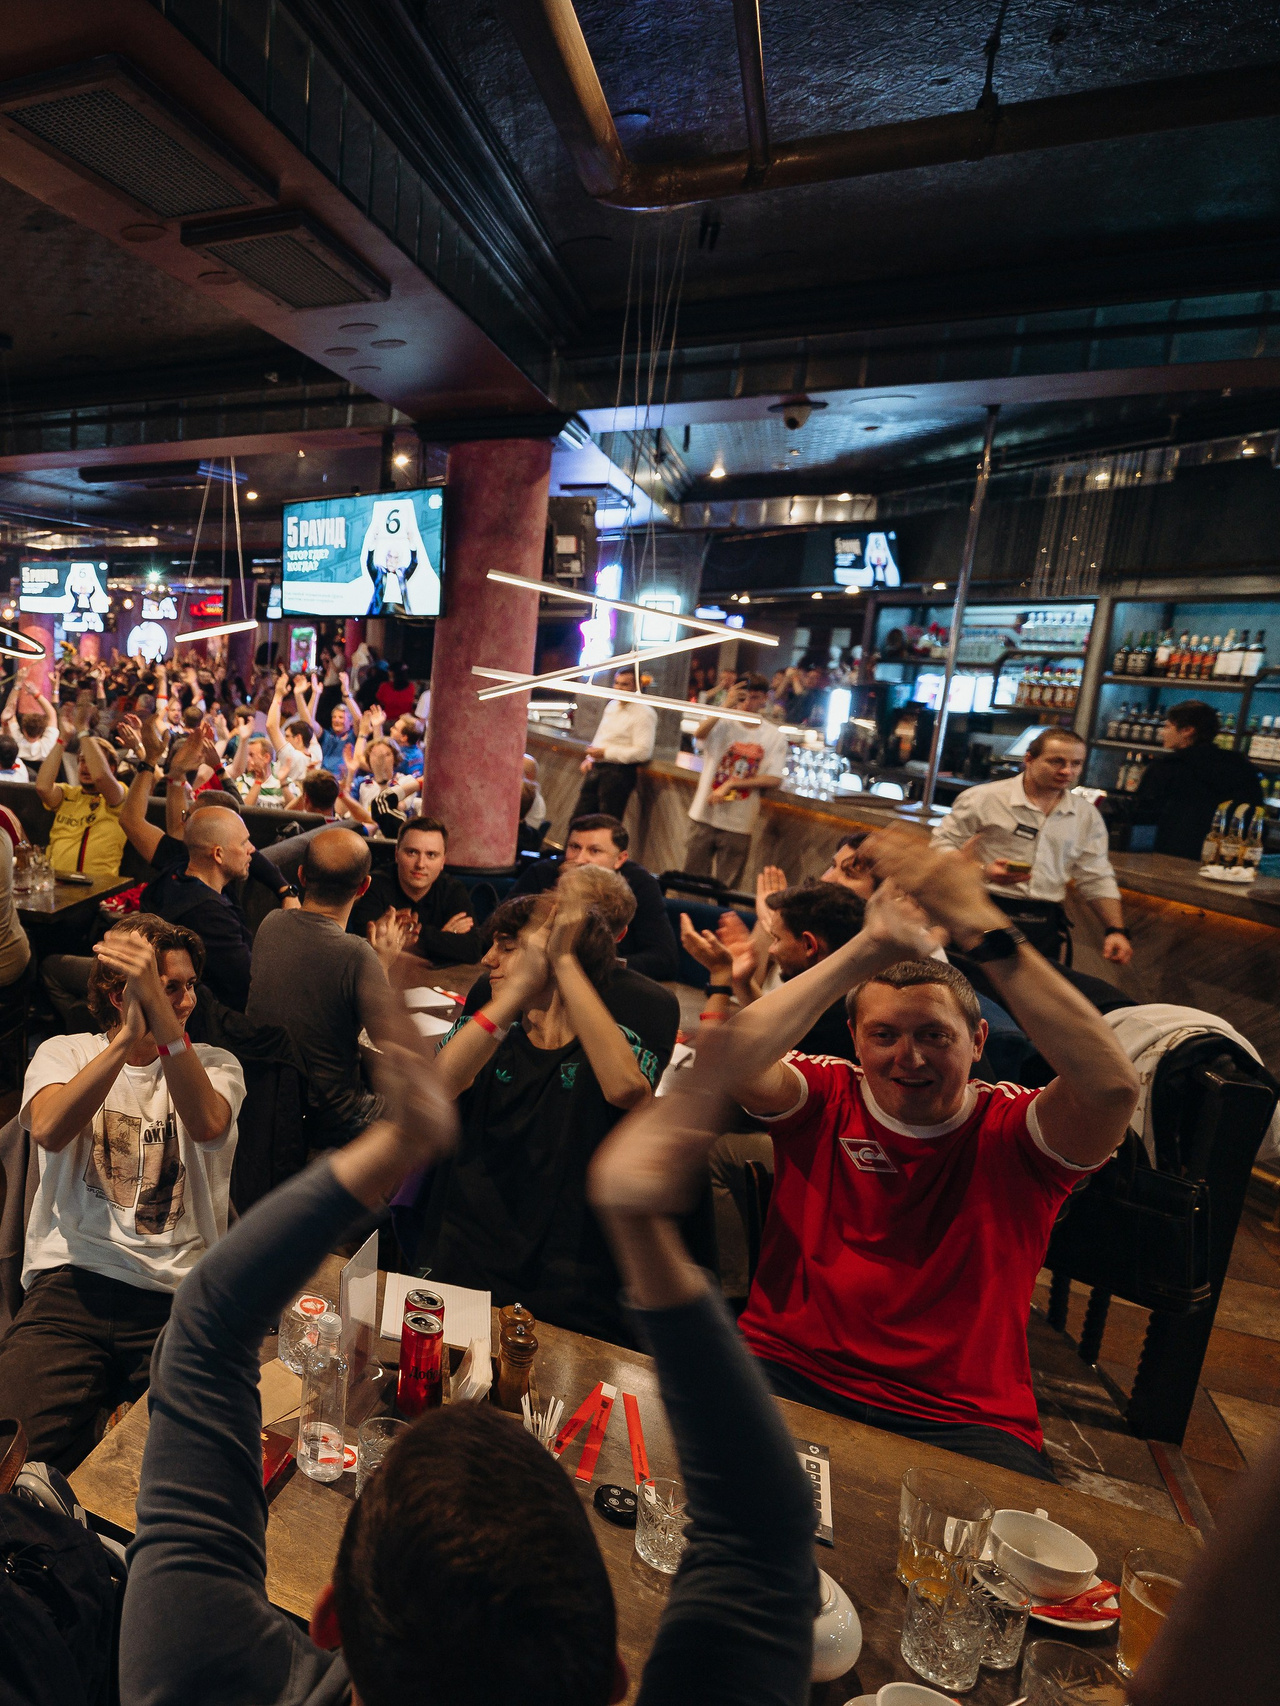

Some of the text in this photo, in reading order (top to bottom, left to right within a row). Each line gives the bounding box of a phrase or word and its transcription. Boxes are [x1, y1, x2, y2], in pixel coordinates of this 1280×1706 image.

[287, 516, 346, 548] 5 РАУНД
[386, 509, 400, 534] 6
